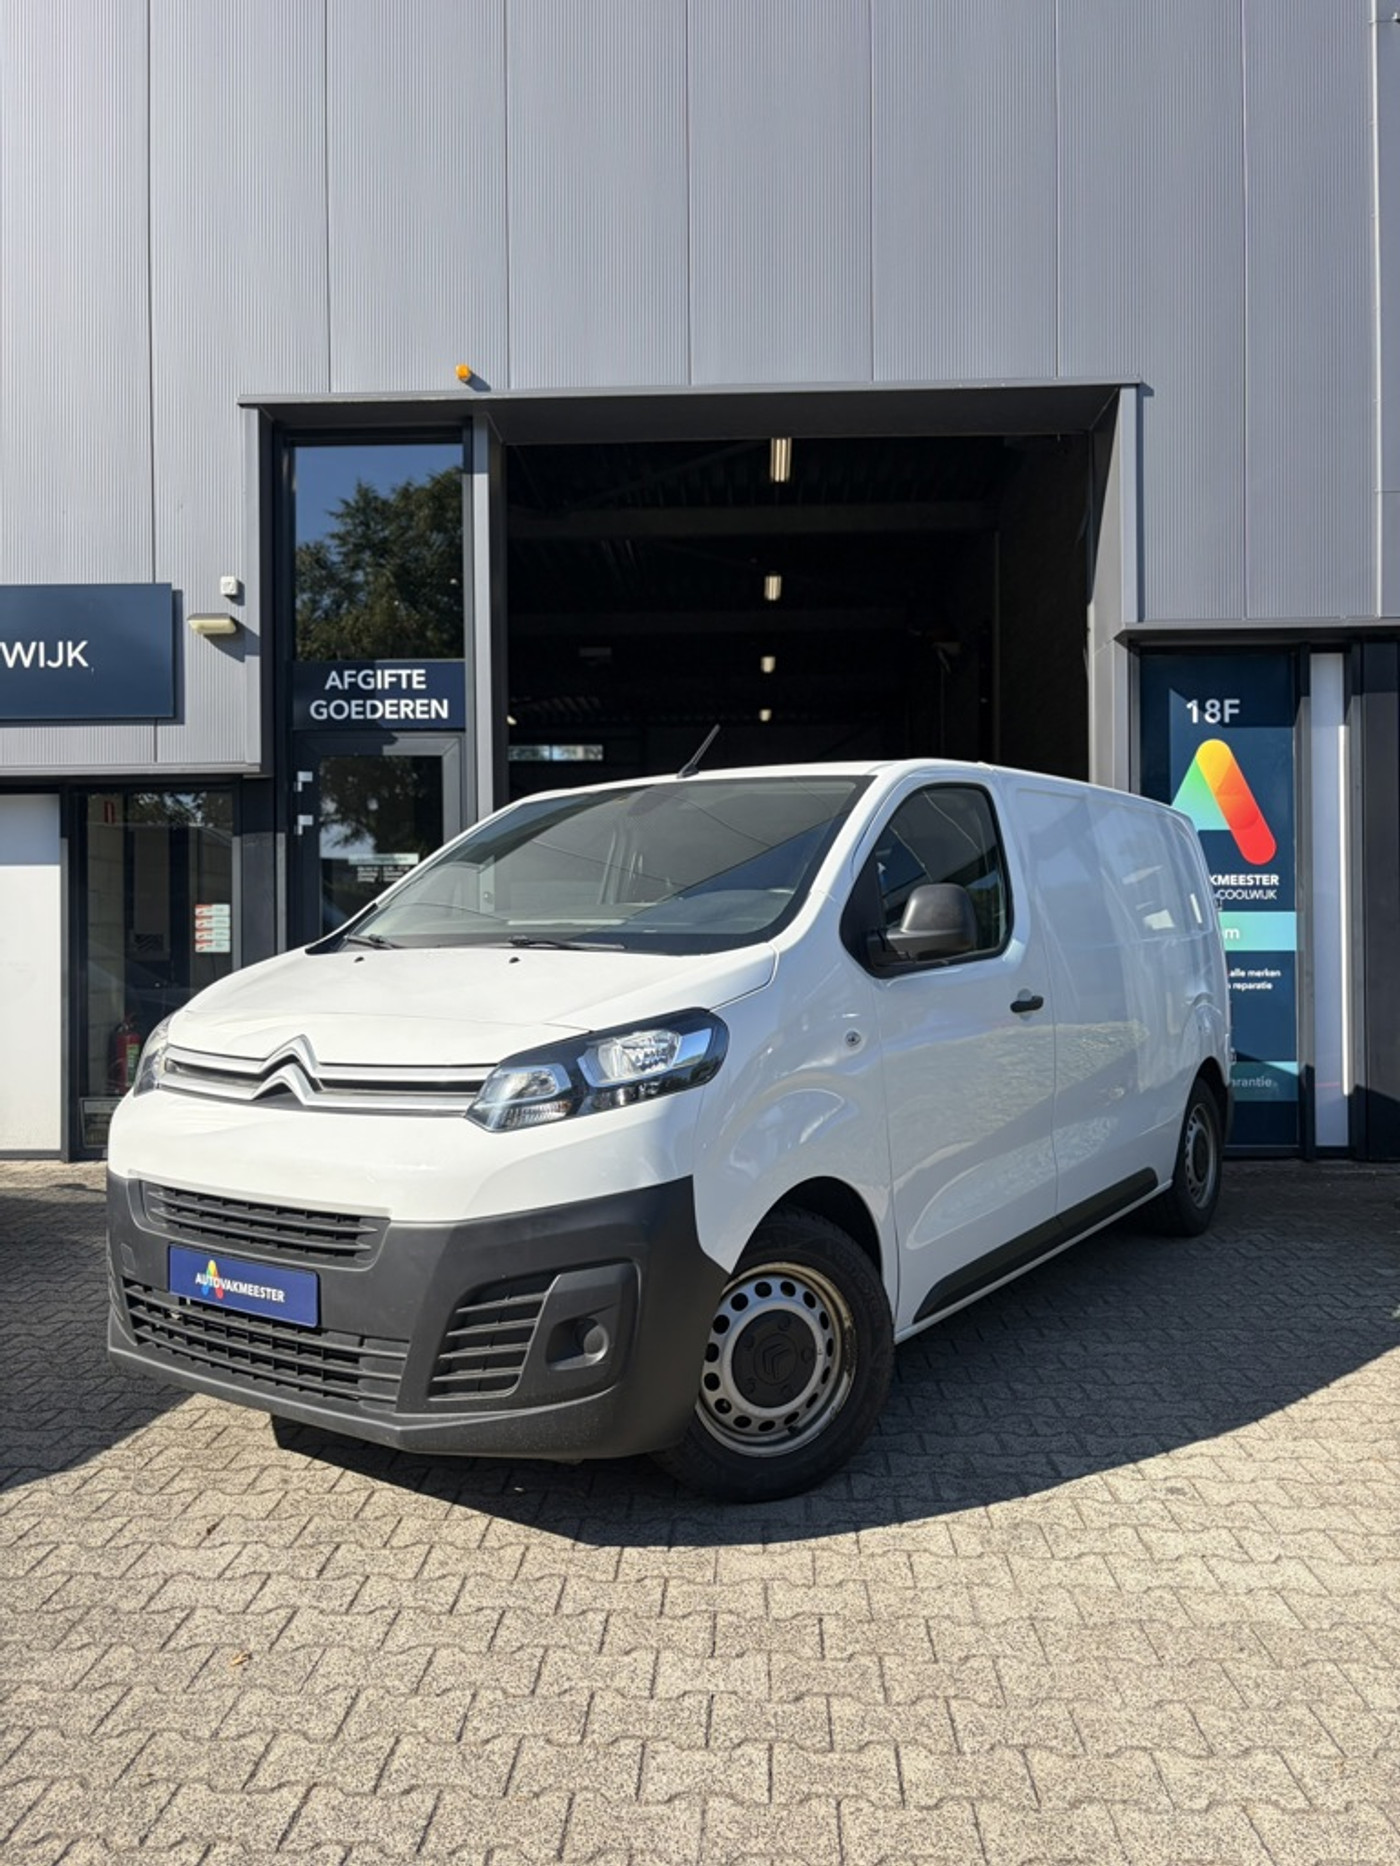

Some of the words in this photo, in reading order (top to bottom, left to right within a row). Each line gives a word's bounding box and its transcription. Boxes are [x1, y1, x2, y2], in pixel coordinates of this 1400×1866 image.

[0, 640, 89, 669] WIJK
[324, 669, 427, 690] AFGIFTE
[309, 699, 448, 720] GOEDEREN
[1186, 699, 1241, 724] 18F
[1230, 968, 1246, 977] alle
[1247, 968, 1281, 977] merken
[1232, 981, 1273, 992] reparatie
[195, 1272, 285, 1303] AUTOVAKMEESTER
